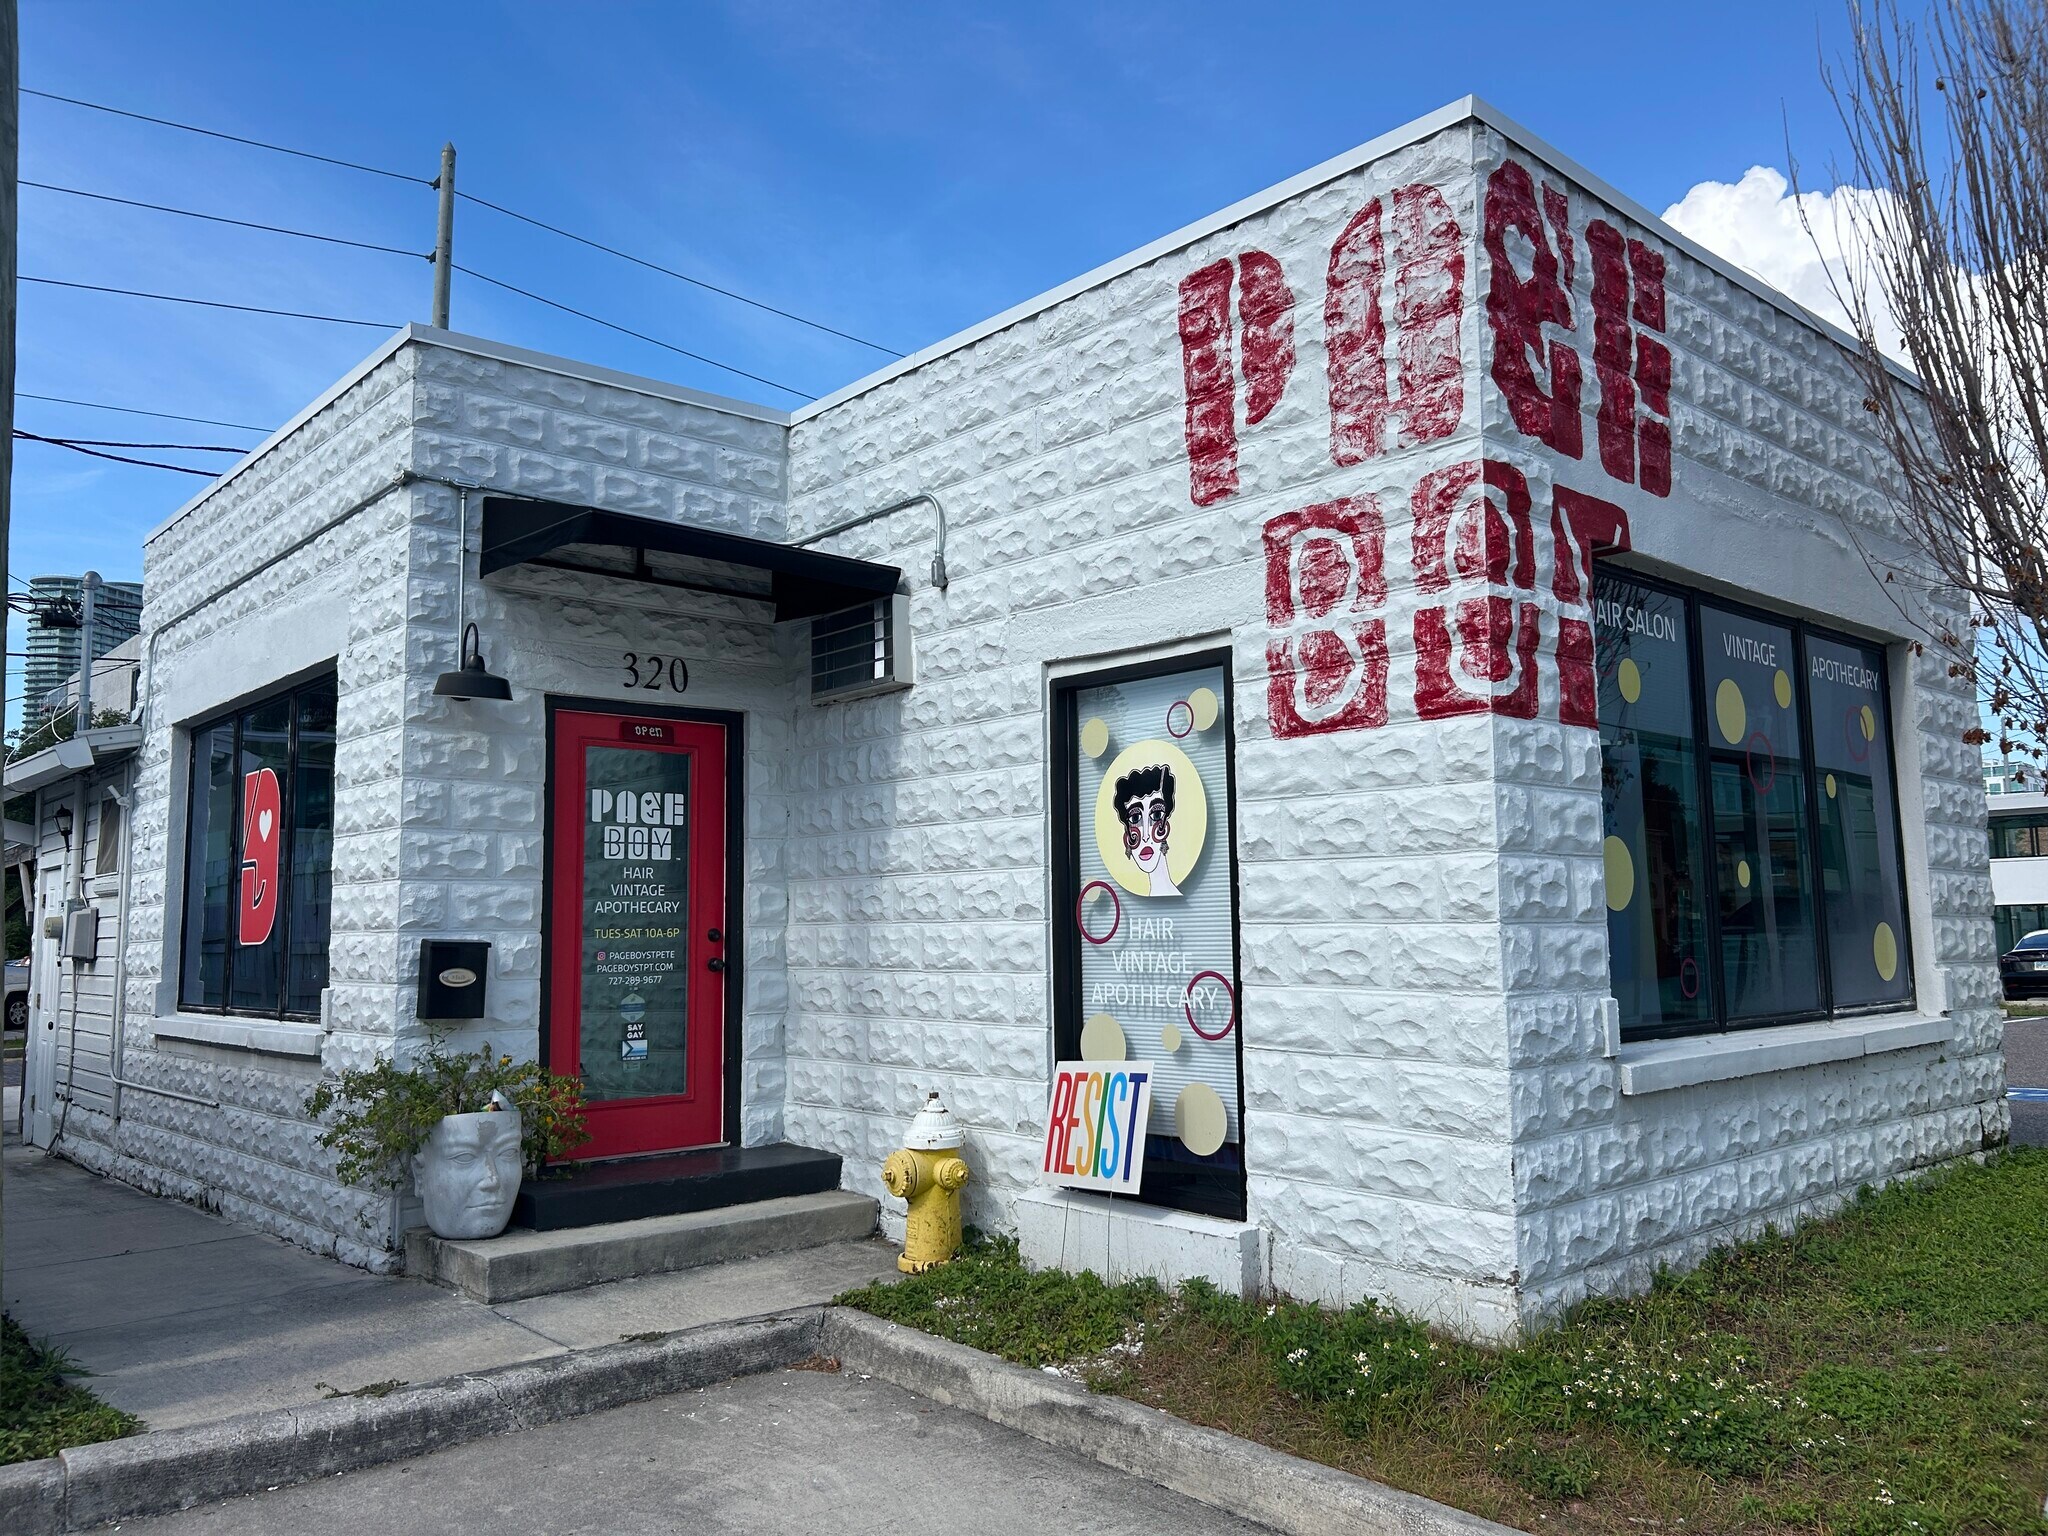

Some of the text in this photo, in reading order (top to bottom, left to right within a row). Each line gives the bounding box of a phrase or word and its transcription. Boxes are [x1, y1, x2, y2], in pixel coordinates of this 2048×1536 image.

[1596, 598, 1677, 643] AIR SALON
[1722, 632, 1777, 668] VINTAGE
[622, 652, 689, 694] 320
[1811, 656, 1880, 693] APOTHECARY
[591, 788, 685, 826] PAGE
[603, 825, 672, 861] BOY
[623, 866, 654, 880] HAIR
[610, 883, 666, 897] VINTAGE
[594, 901, 681, 914] APOTHECARY
[594, 927, 680, 939] TUES-SAT 10A-6P
[1129, 917, 1175, 940] HAIR
[609, 950, 676, 960] PAGEBOYSTPETE
[1112, 950, 1193, 975] VINTAGE
[596, 962, 674, 973] PAGEBOYSTPT.COM
[608, 975, 663, 986] 727-289-9677
[1090, 982, 1219, 1011] APOTHECARY
[626, 1031, 644, 1039] GAY
[627, 1023, 644, 1031] SAY
[1043, 1071, 1149, 1184] RESIST
